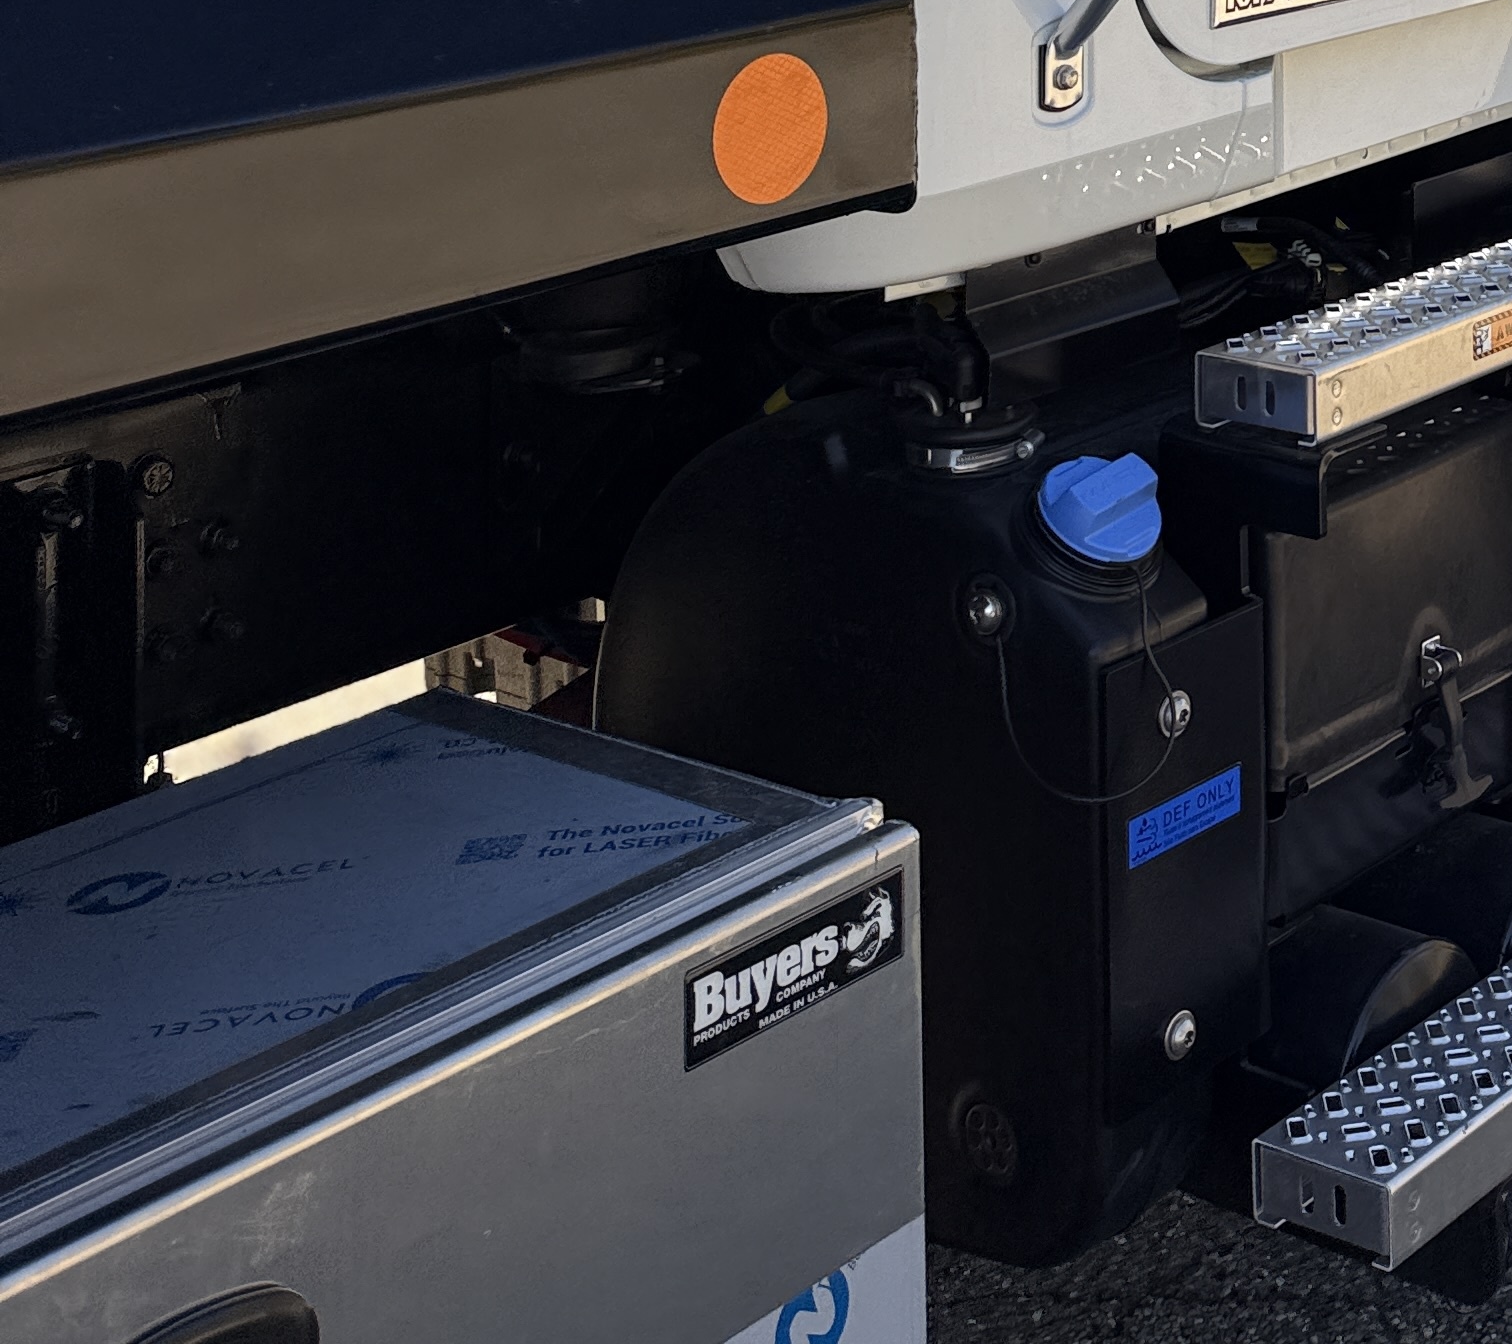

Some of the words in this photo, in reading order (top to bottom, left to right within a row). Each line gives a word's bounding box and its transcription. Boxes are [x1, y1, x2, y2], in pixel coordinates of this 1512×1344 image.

[1163, 799, 1192, 828] DEF
[1196, 777, 1235, 809] ONLY
[537, 845, 576, 858] for
[583, 835, 671, 854] LASER
[548, 828, 593, 841] The
[600, 816, 705, 836] Novacel
[175, 858, 356, 889] NOVACEL
[693, 925, 838, 1033] Buyers
[150, 1003, 346, 1038] NOVACEL
[693, 1009, 750, 1047] PRODUCTS
[776, 968, 827, 1003] COMPANY
[758, 1004, 791, 1029] MADE
[793, 997, 805, 1011] IN
[807, 981, 838, 1004] U.S.A.
